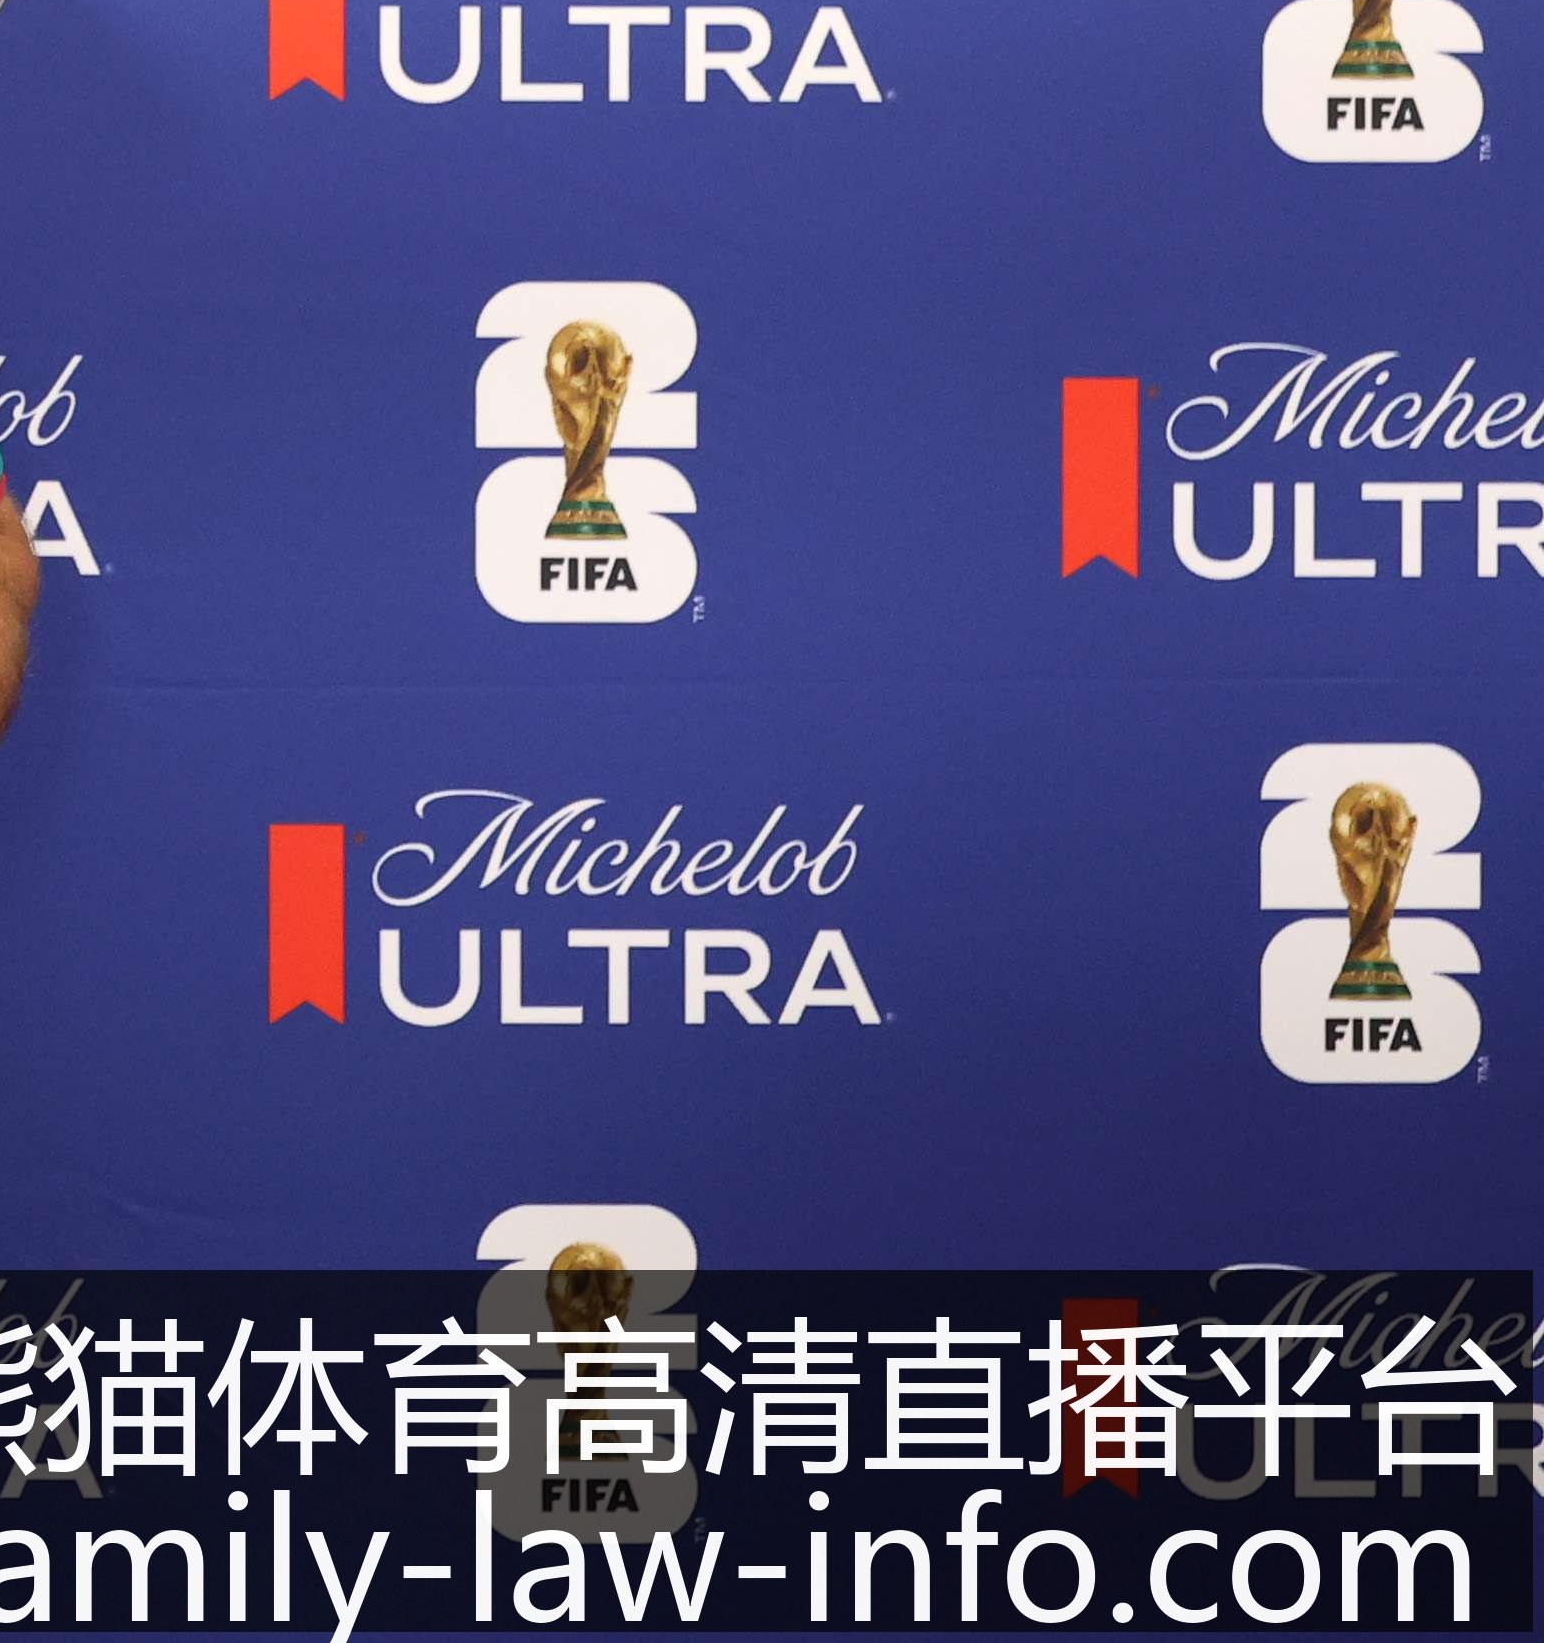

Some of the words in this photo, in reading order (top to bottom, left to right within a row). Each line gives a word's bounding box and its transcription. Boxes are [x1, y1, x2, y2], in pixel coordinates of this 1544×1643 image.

[379, 5, 882, 104] ULTRA
[1326, 96, 1425, 131] FIFA
[1172, 481, 1544, 581] ULTR
[539, 556, 638, 592] FIFA
[371, 789, 864, 907] Michelob
[379, 928, 882, 1027] ULTRA
[1324, 1017, 1423, 1053] FIFA
[540, 1477, 641, 1514] FIFA
